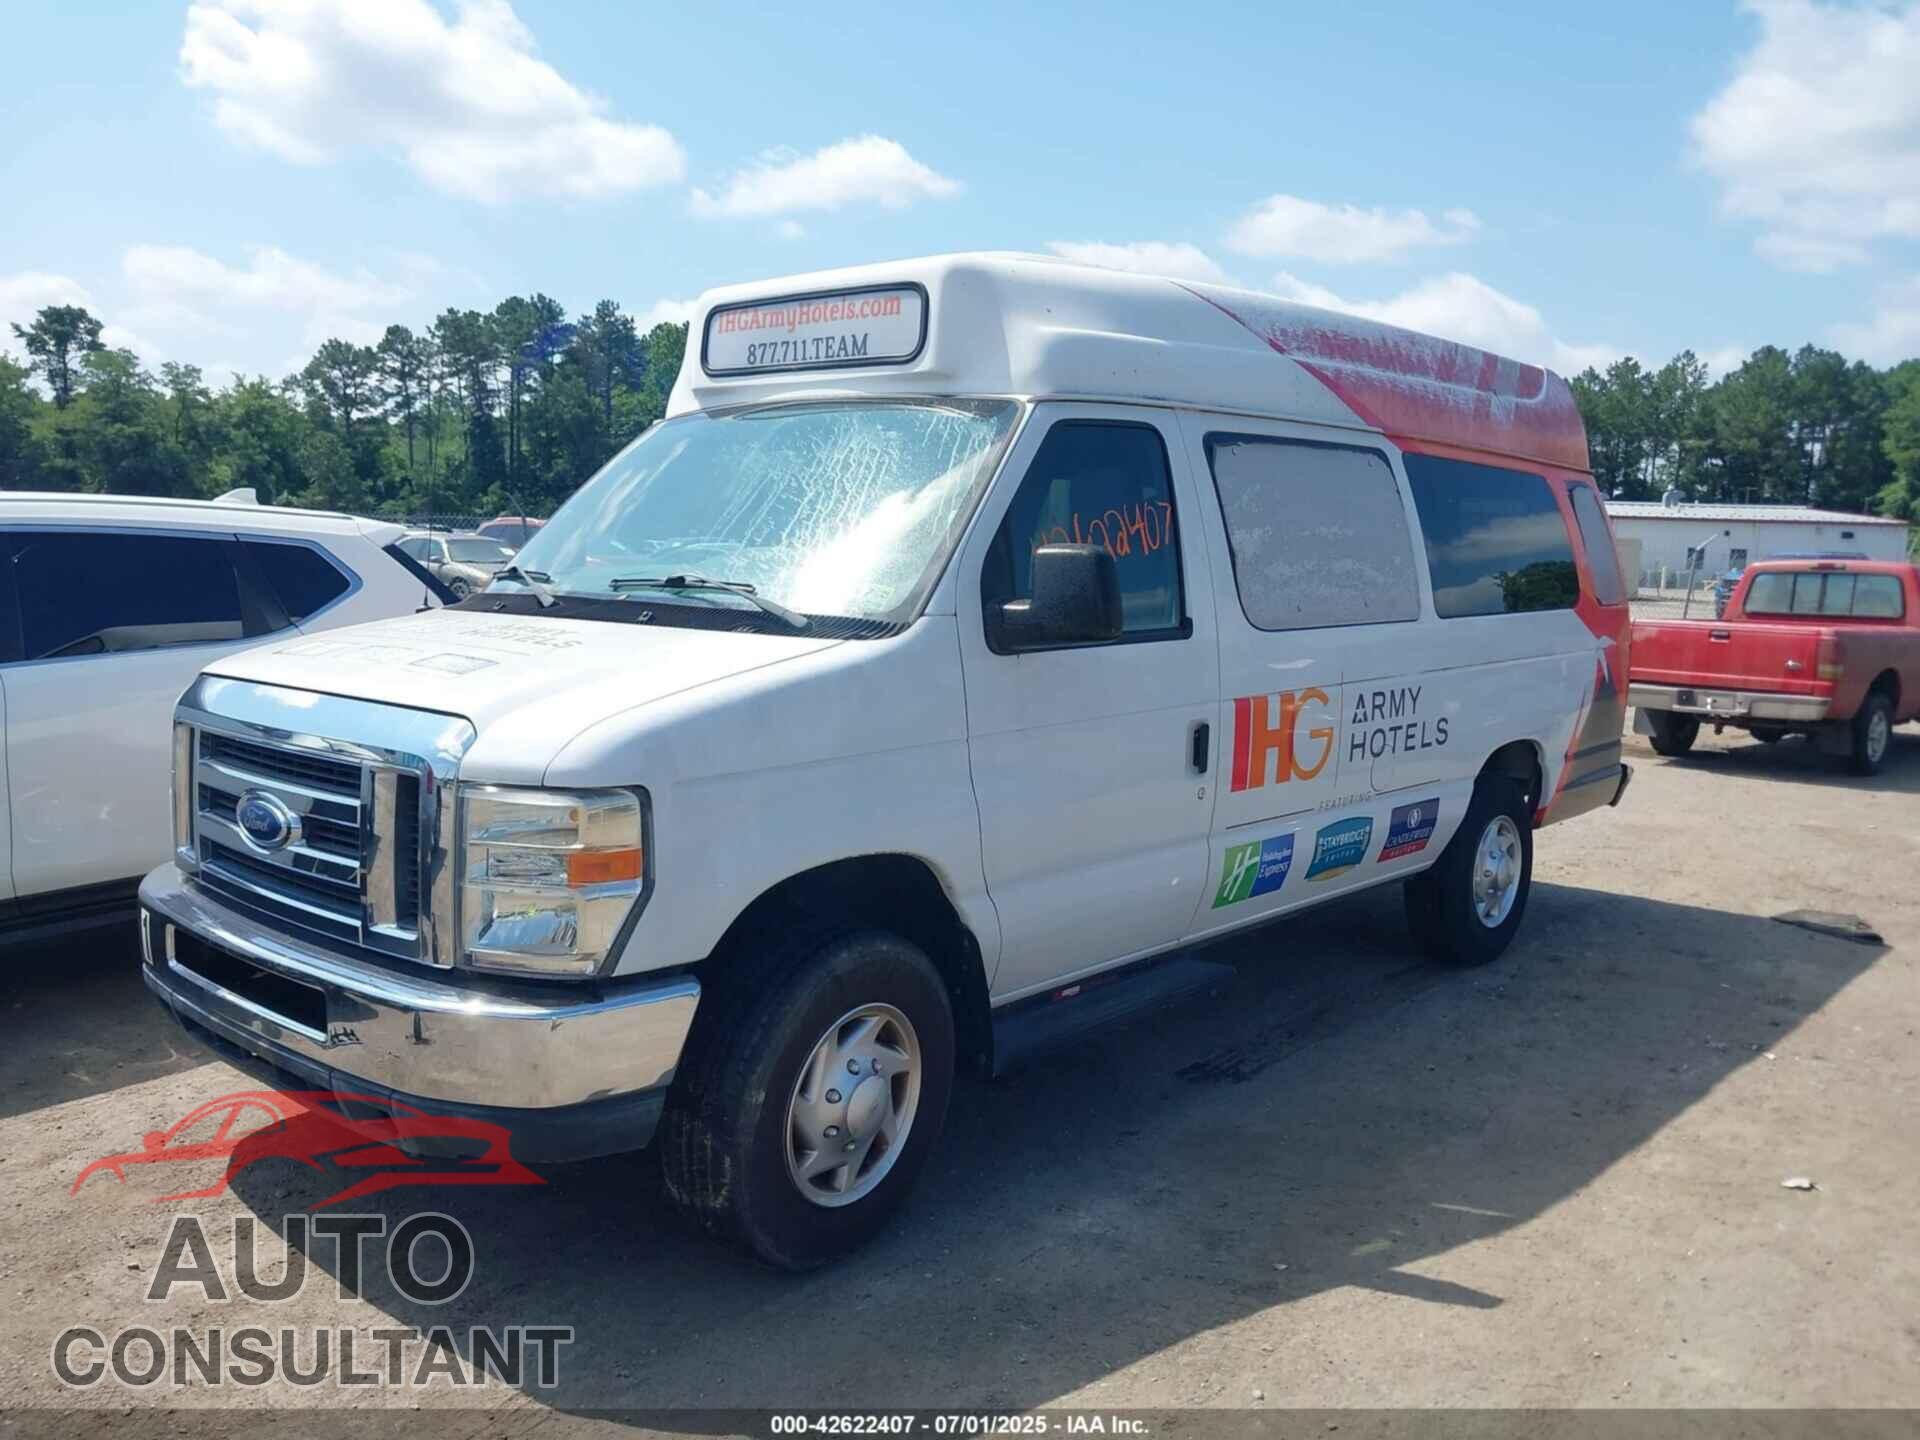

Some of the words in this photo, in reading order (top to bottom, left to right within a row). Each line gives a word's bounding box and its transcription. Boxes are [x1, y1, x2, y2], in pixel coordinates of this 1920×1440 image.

[718, 296, 901, 334] IHGArmyHotels.com
[747, 333, 868, 365] 877.711.TEAM
[1352, 685, 1422, 724] ARMY
[1230, 687, 1334, 792] IHG
[1349, 717, 1449, 763] HOTELS
